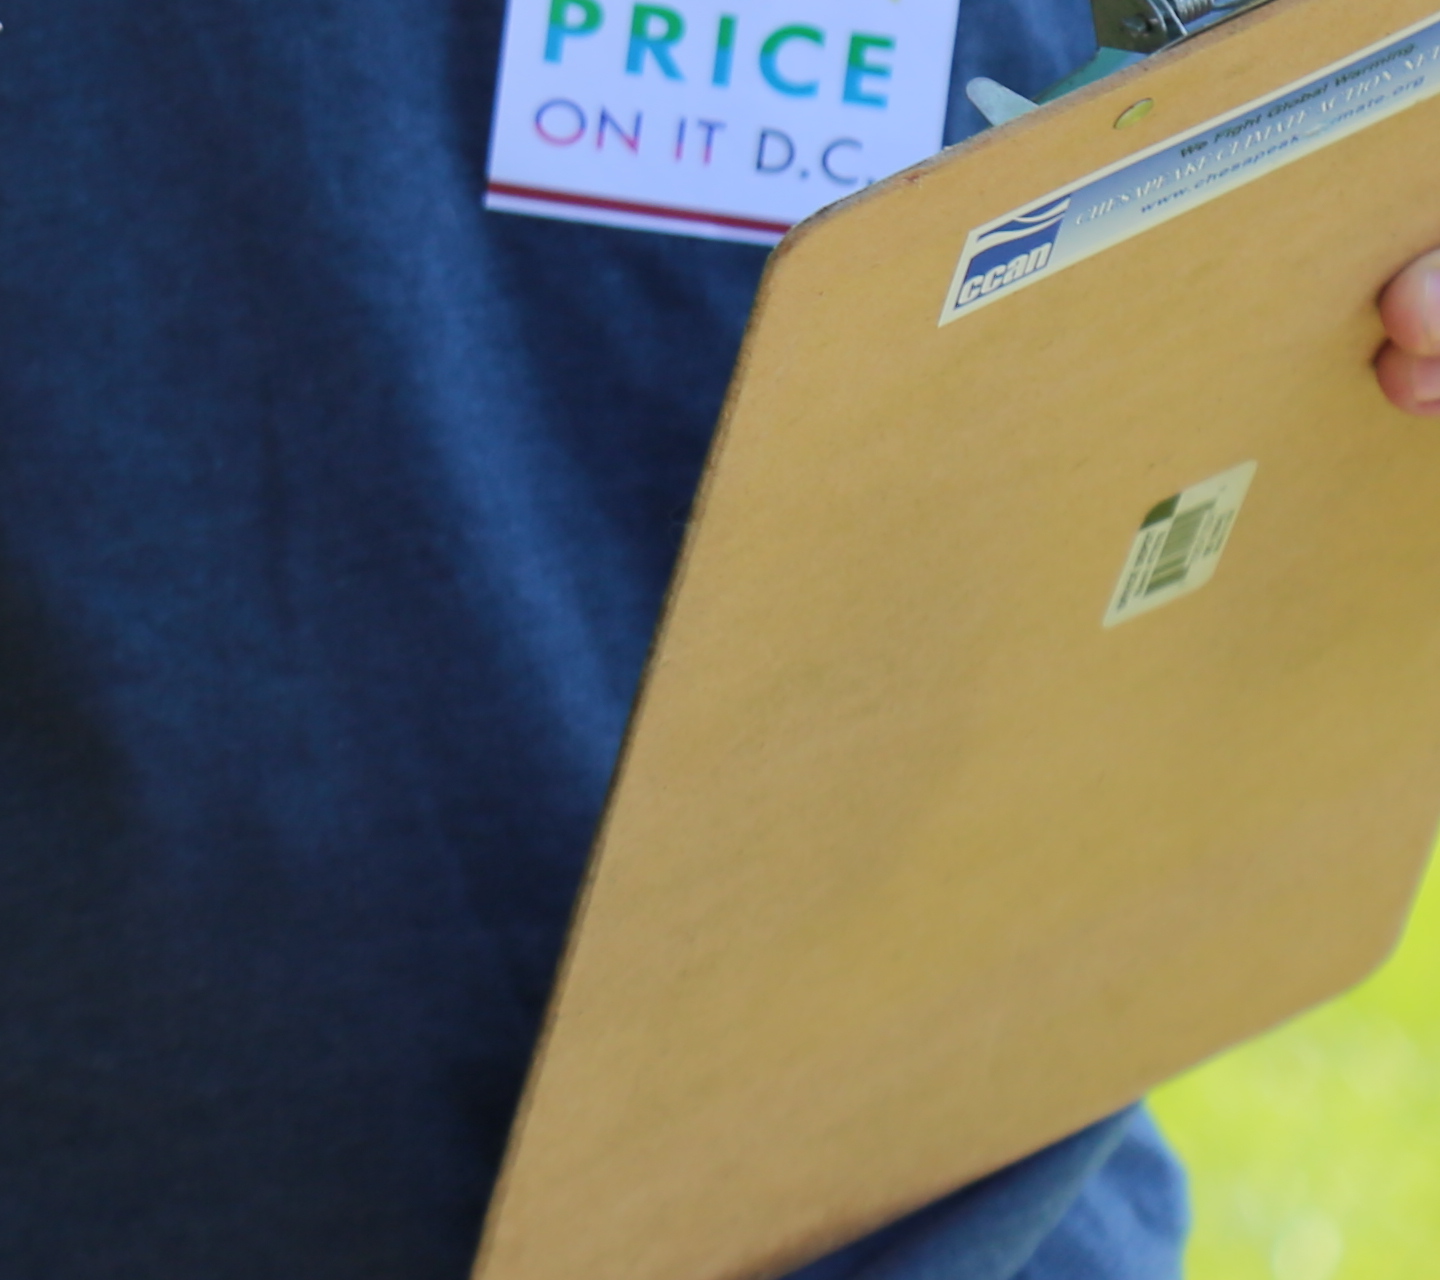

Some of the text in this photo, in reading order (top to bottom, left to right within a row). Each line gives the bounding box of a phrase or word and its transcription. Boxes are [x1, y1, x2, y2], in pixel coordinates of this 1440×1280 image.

[534, 98, 643, 155] ON
[674, 119, 727, 167] IT
[1181, 140, 1209, 158] We
[1266, 83, 1329, 118] Global
[1215, 105, 1312, 161] CLIMATE
[1316, 66, 1395, 113] ACTION
[957, 241, 1053, 306] ccan
